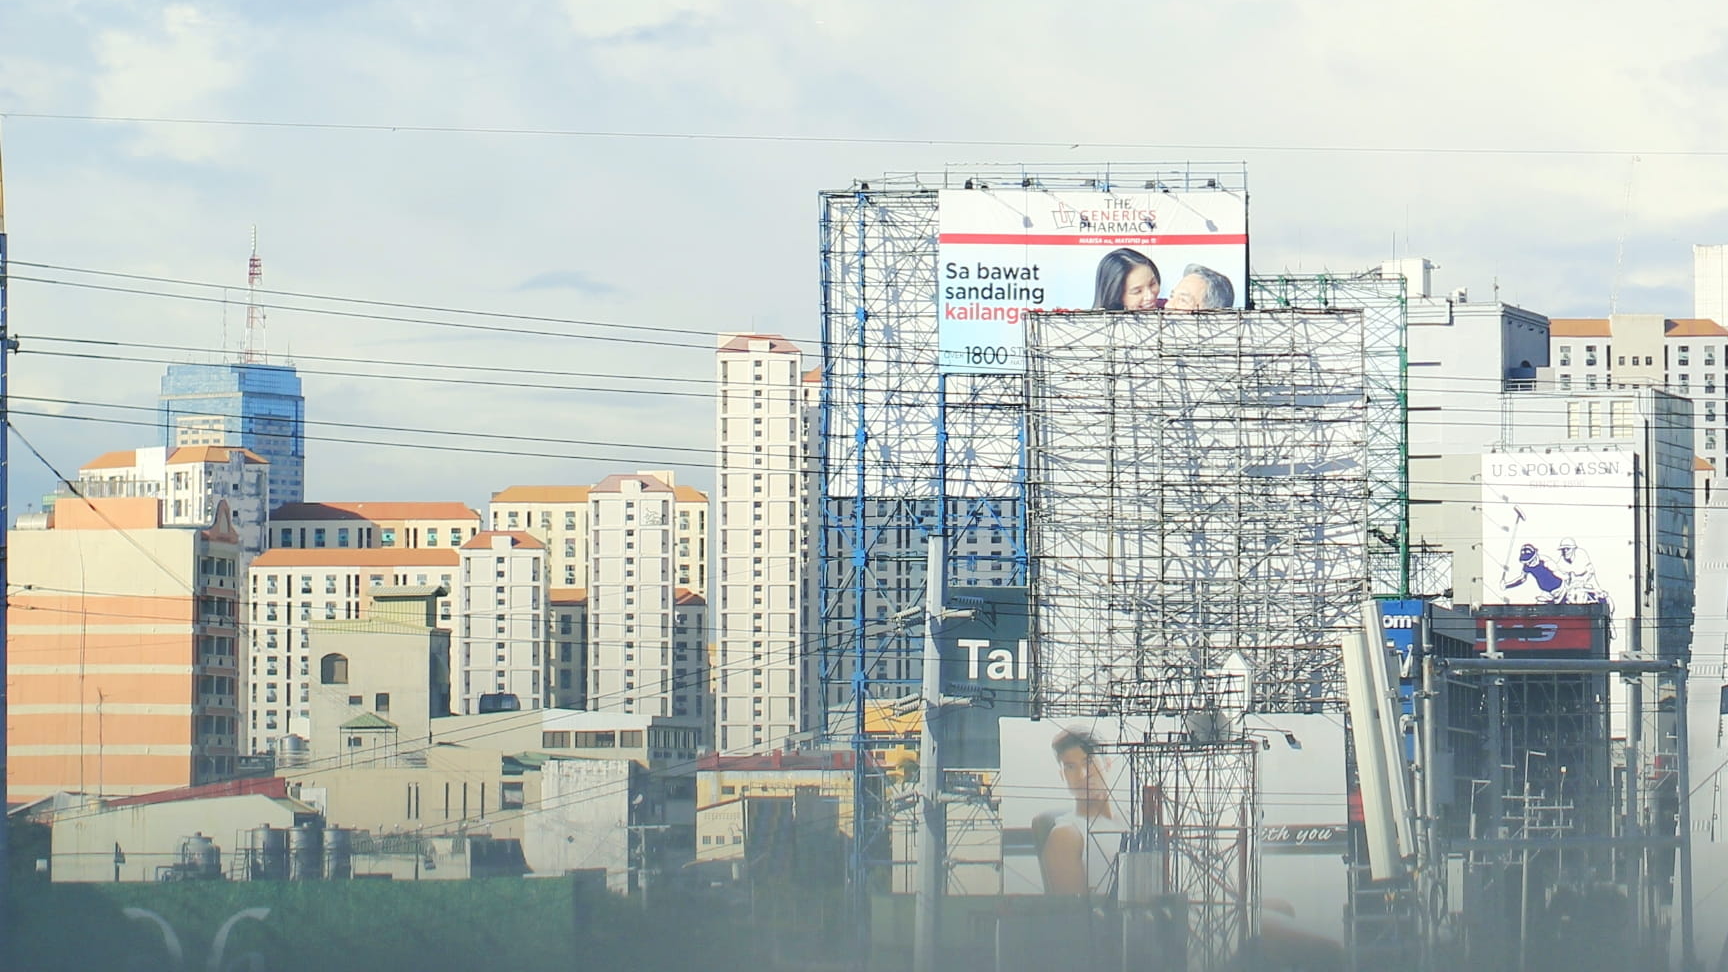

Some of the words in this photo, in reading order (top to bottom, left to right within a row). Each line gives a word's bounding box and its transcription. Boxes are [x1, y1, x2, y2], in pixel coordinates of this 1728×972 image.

[1104, 198, 1132, 210] THE
[1079, 209, 1157, 222] GENERICS
[1079, 221, 1158, 233] PHARMACY
[945, 262, 970, 279] Sa
[977, 262, 1040, 281] bawat
[945, 283, 1044, 304] sandaling
[965, 346, 1008, 365] 1800
[1491, 464, 1520, 477] U.S.
[1526, 462, 1571, 476] POLO
[1382, 614, 1412, 629] om
[1295, 828, 1333, 846] you
